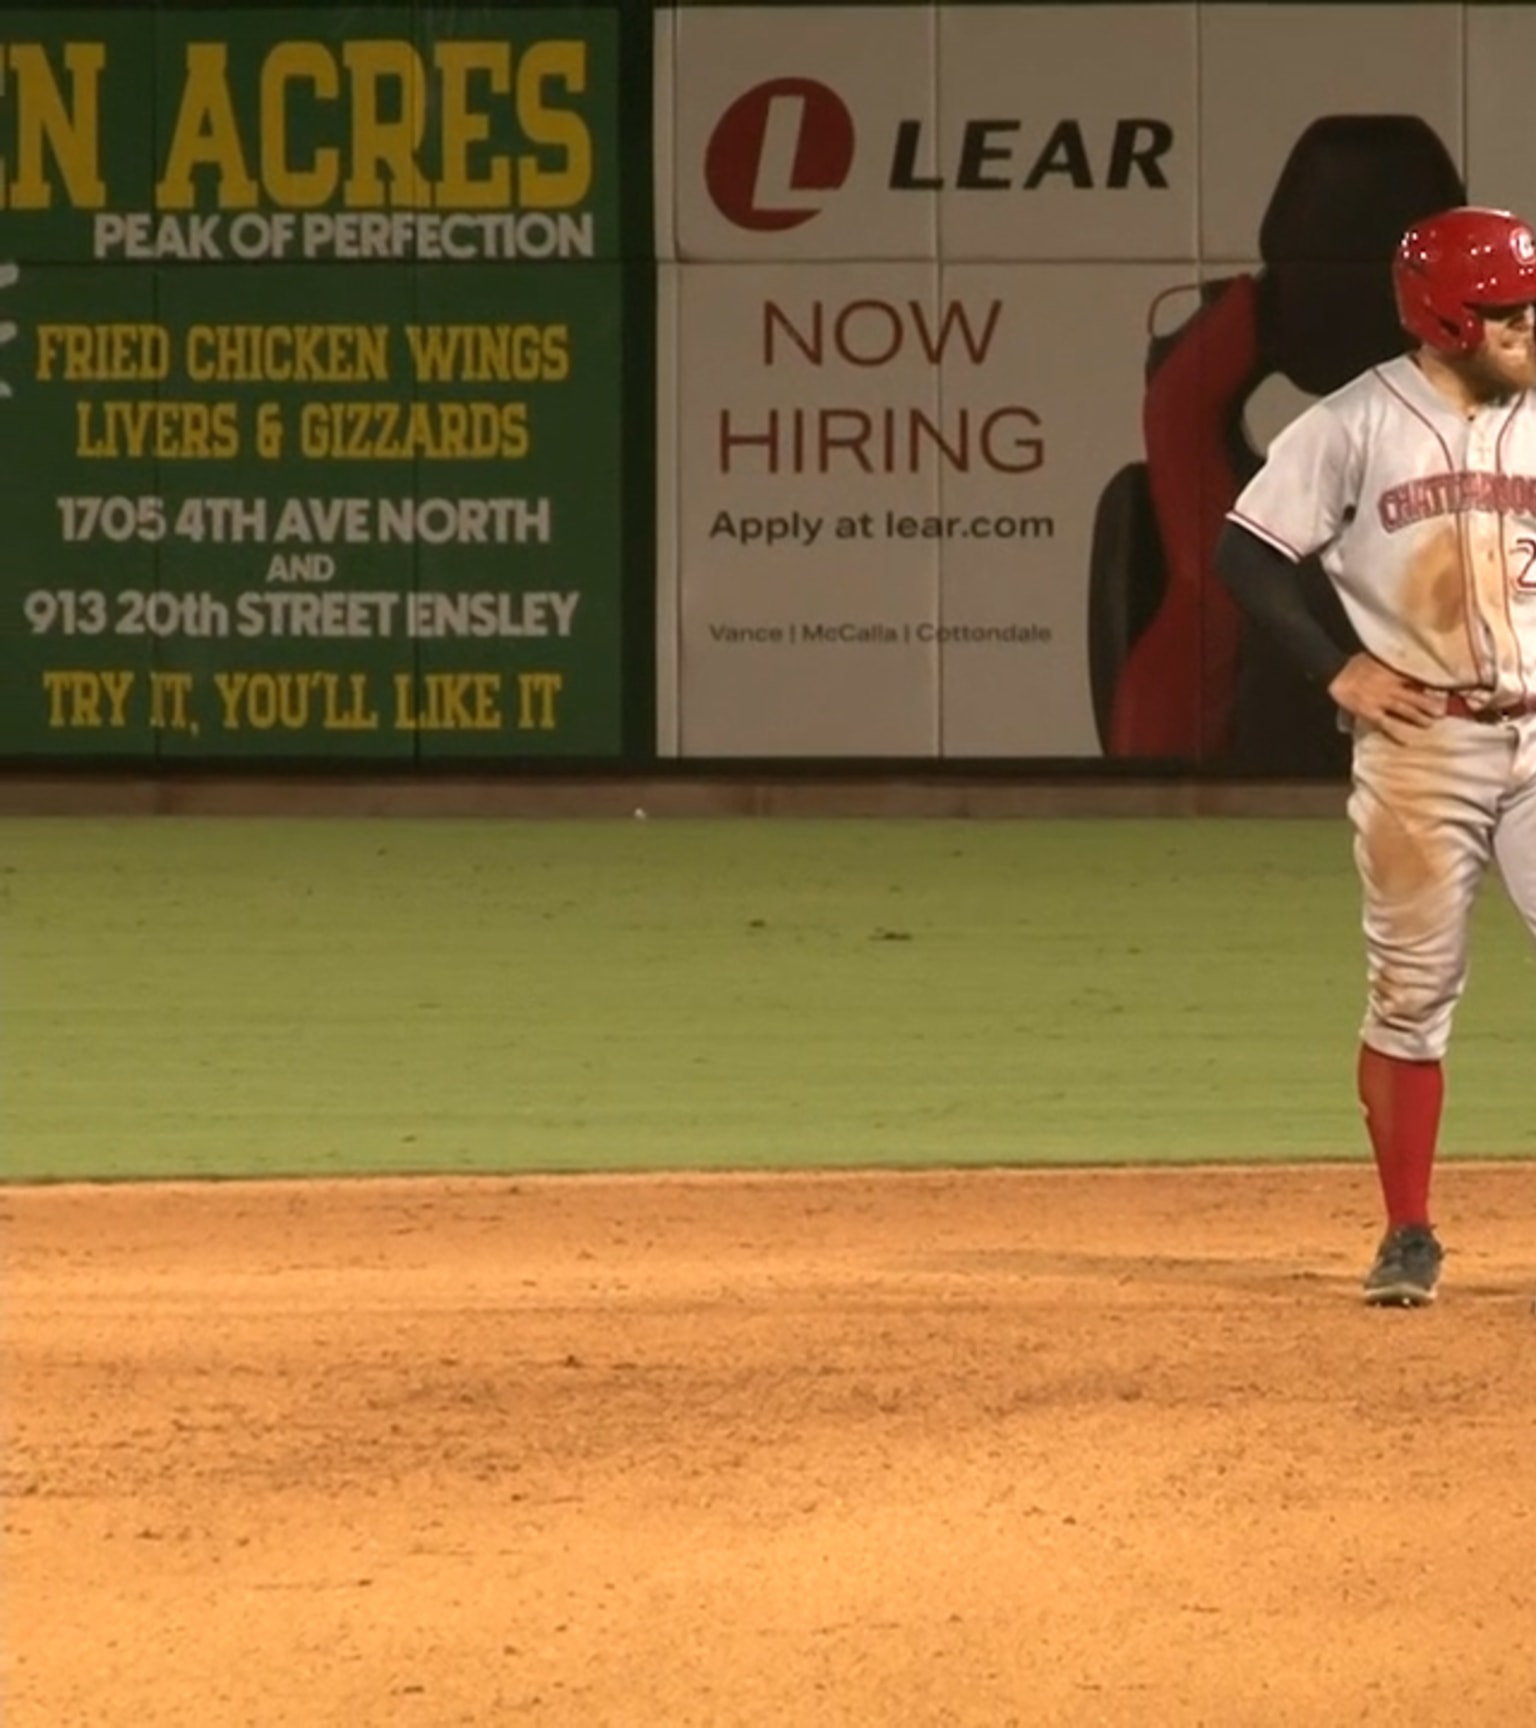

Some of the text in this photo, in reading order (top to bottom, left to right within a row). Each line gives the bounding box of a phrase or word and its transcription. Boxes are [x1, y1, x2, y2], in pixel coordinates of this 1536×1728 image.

[0, 40, 593, 209] N ACRES
[889, 119, 1174, 190] LEAR
[94, 213, 594, 259] PEAK OF PERFECTION
[36, 325, 570, 381] FRIED CHICKEN WINGS
[764, 300, 1002, 366] NOW
[76, 402, 529, 459] LIVERS & GIZZARDS
[720, 406, 1044, 474] HIRING
[57, 497, 551, 543] 1705 4TH AVE NORTH
[709, 511, 1054, 546] Apply at lear.com
[266, 554, 335, 583] AND
[25, 591, 580, 637] 913 20th STREET ENSLEY
[709, 625, 783, 643] Vance
[802, 623, 897, 643] McCalla
[917, 623, 1051, 644] Cottondale
[43, 671, 562, 736] TRY IT, YOU'LL LIKE IT
